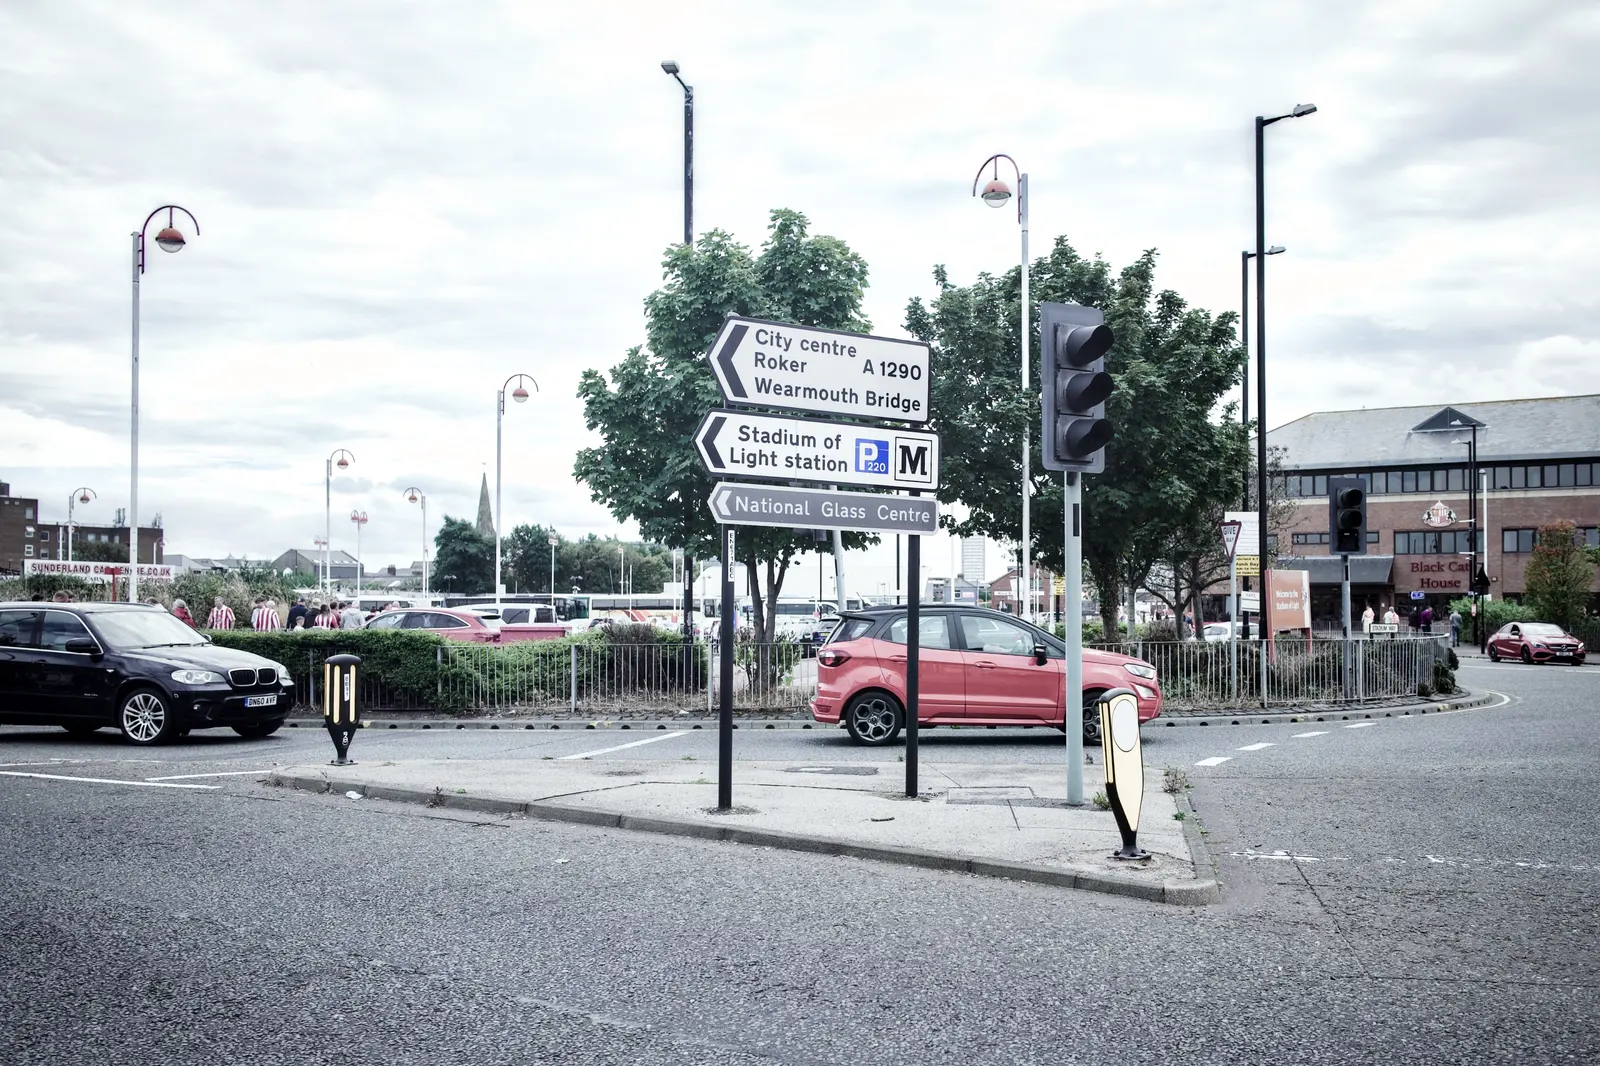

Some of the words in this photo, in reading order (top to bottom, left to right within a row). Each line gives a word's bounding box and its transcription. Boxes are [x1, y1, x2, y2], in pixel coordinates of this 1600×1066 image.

[755, 328, 792, 352] City
[800, 339, 857, 358] centre
[754, 352, 807, 373] Roker
[862, 359, 875, 375] A
[880, 361, 922, 380] 1290
[754, 376, 859, 404] Wearmouth
[866, 390, 921, 413] Bridge
[738, 425, 817, 448] Stadium
[824, 434, 842, 450] of
[730, 446, 778, 468] Light
[784, 453, 848, 473] station
[859, 442, 879, 471] P
[867, 461, 886, 472] 220
[899, 445, 928, 476] M
[735, 495, 810, 516] National
[821, 501, 866, 519] Glass
[877, 504, 931, 523] Centre
[1223, 526, 1236, 535] GIVE
[31, 562, 91, 574] SUNDERLAND
[1410, 561, 1446, 573] Black
[1448, 561, 1470, 573] Cat
[1420, 577, 1461, 589] House
